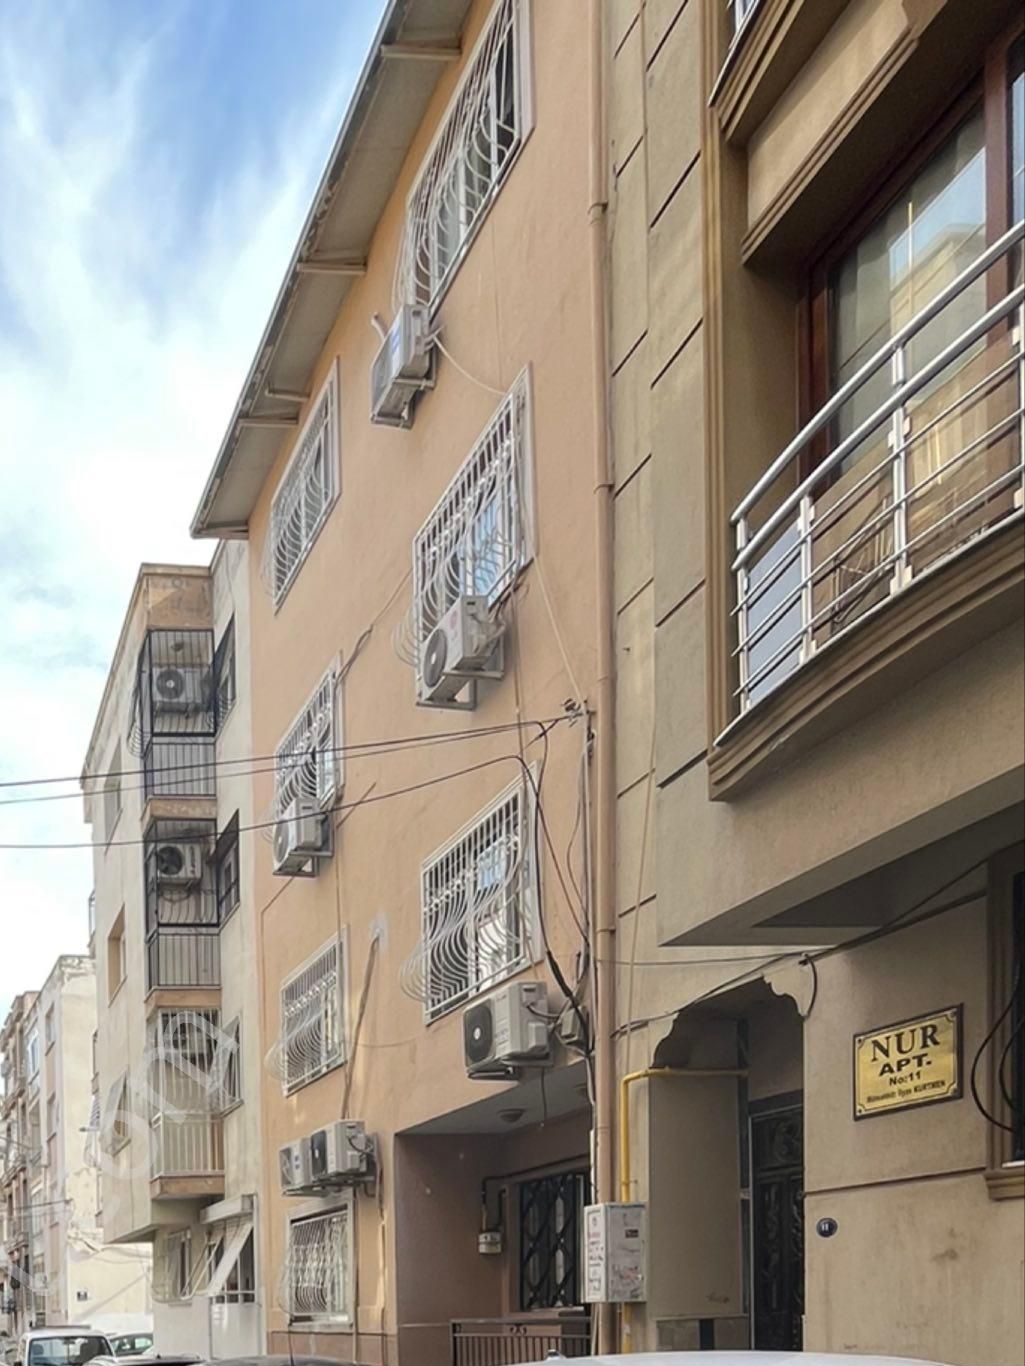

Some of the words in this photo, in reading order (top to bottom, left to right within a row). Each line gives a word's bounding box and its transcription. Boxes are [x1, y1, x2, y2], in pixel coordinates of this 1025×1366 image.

[871, 1024, 940, 1062] NUR
[879, 1053, 932, 1076] APT.
[889, 1071, 921, 1086] No:11
